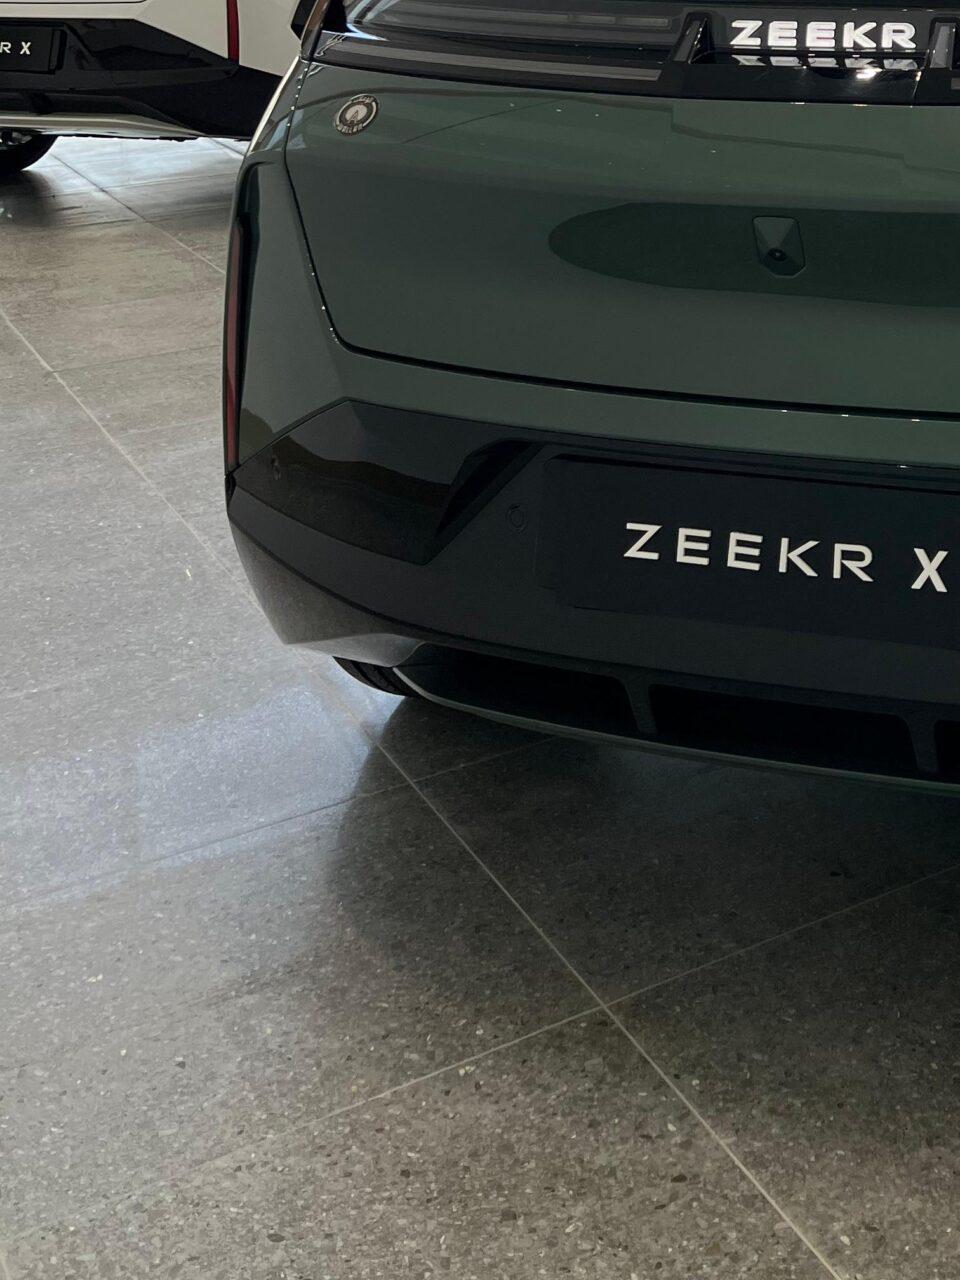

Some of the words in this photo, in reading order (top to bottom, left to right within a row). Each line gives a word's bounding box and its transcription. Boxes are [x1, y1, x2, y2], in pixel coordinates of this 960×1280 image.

[20, 41, 31, 55] X
[731, 20, 916, 49] ZEEKR
[623, 523, 874, 583] ZEEKR
[911, 548, 949, 593] X
